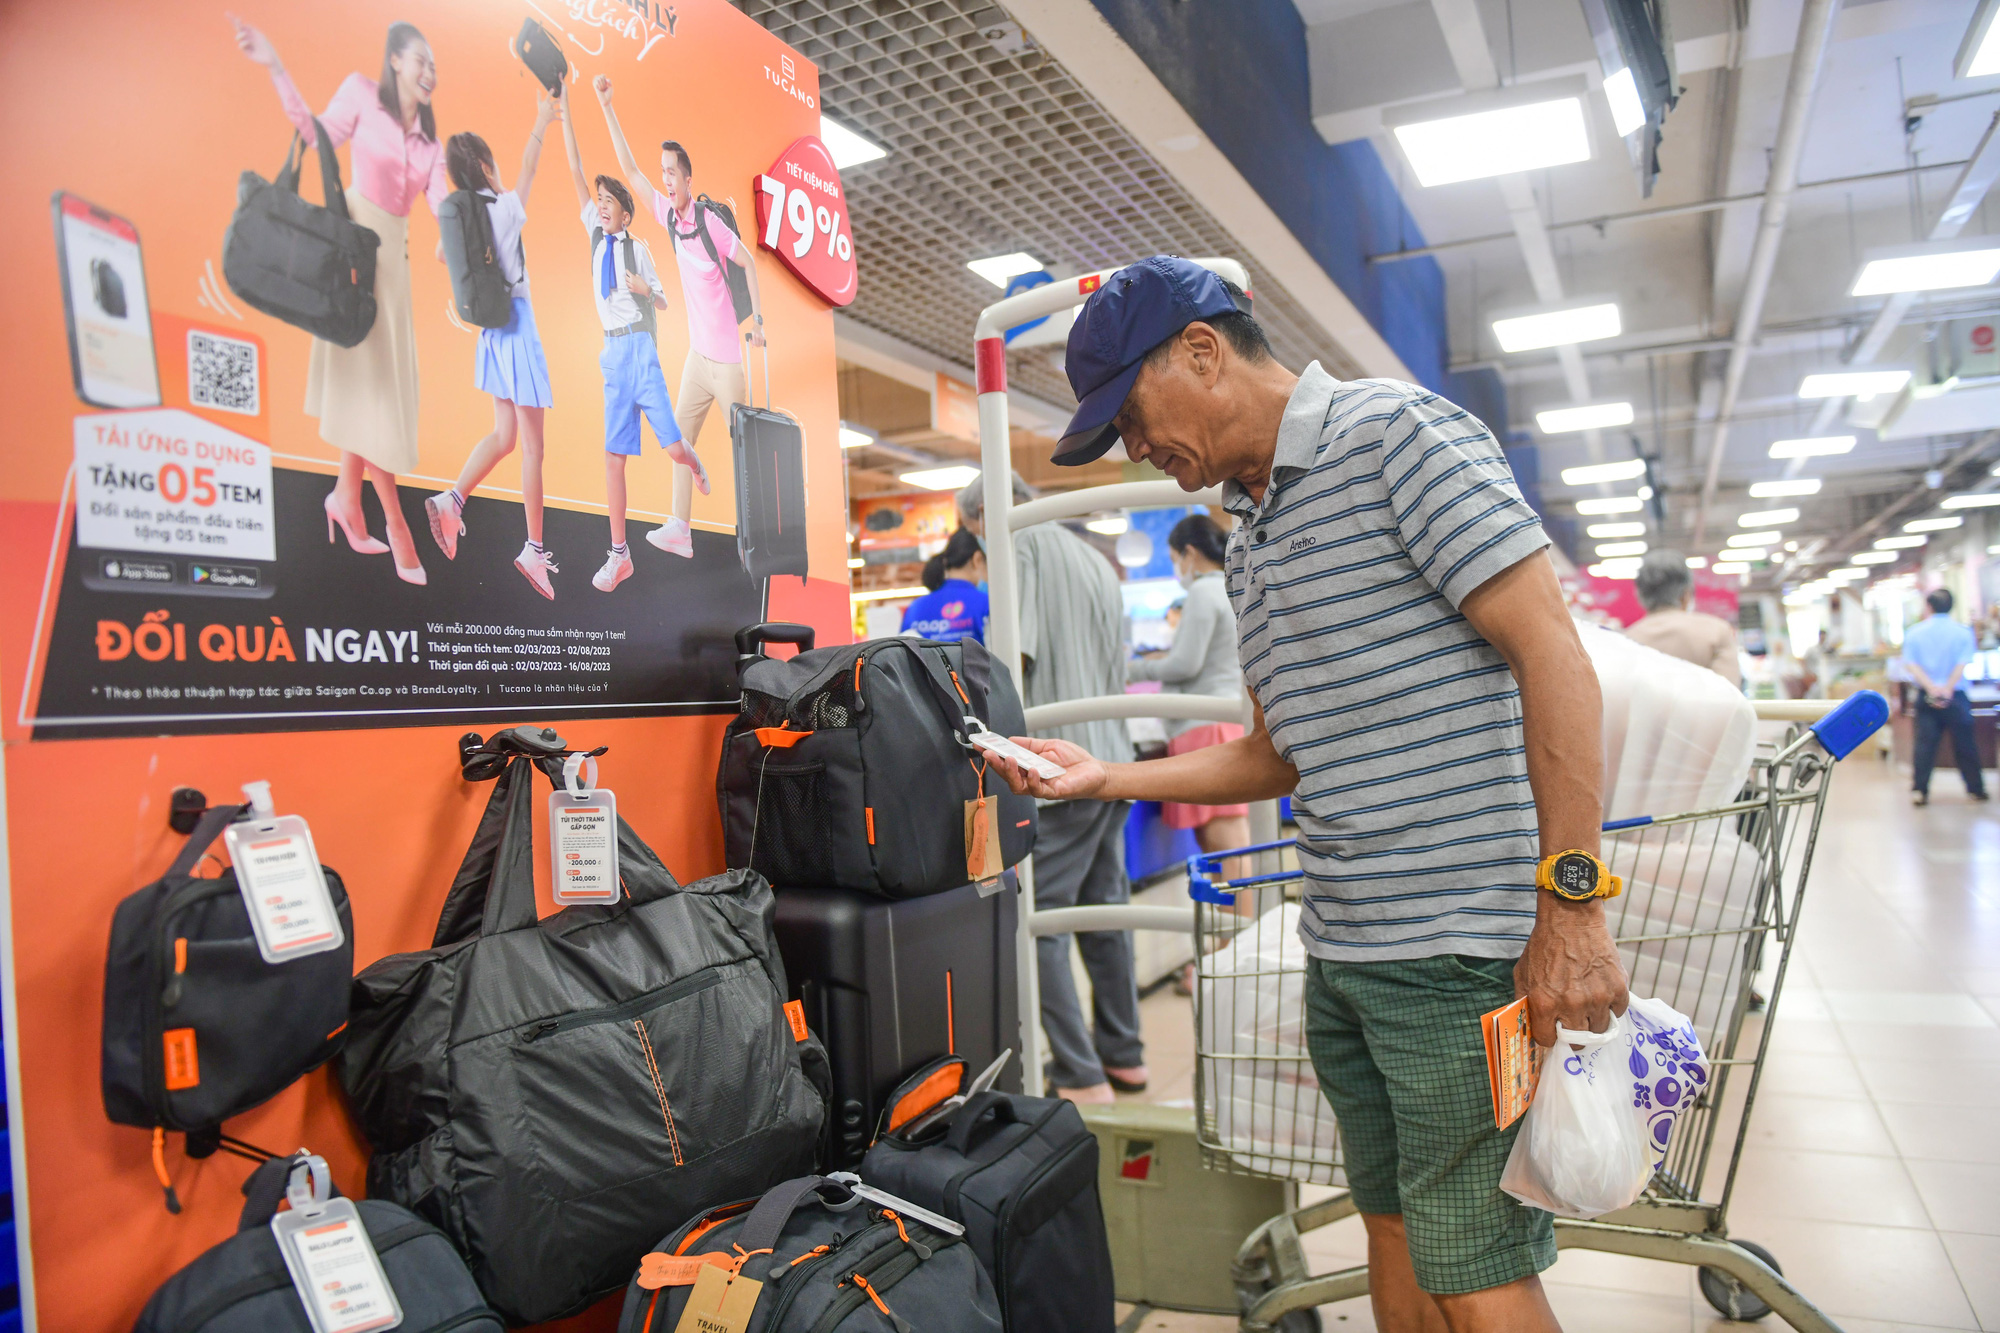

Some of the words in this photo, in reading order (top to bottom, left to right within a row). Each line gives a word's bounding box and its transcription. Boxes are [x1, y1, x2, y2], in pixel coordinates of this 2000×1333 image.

[764, 65, 815, 109] TUCANO
[786, 161, 803, 180] TIẾT
[803, 167, 822, 191] KIỆM
[822, 178, 839, 199] ĐẾN
[761, 173, 851, 262] 79%
[94, 424, 129, 447] TẢI
[137, 428, 188, 456] ỨNG
[195, 442, 256, 466] DỤNG
[89, 463, 155, 494] TẶNG
[158, 462, 217, 507] 05
[219, 483, 262, 506] TEM
[156, 509, 200, 526] phẩm
[135, 525, 171, 543] tặng
[199, 531, 227, 545] tem
[1290, 537, 1317, 552] Aristino
[122, 568, 142, 580] App
[144, 569, 171, 581] Store
[210, 573, 238, 586] Google
[95, 609, 186, 662] ĐỔI
[199, 616, 297, 662] QUÀ
[305, 627, 420, 663] NGAY!
[426, 622, 444, 634] Với
[446, 621, 463, 634] mỗi
[465, 624, 502, 635] 200.000
[503, 625, 526, 638] đồng
[527, 628, 545, 637] mua
[546, 626, 563, 637] sắm
[564, 627, 584, 640] nhận
[585, 630, 604, 641] ngay
[610, 630, 626, 640] tem!
[427, 641, 450, 653] Thời
[451, 642, 473, 654] gian
[473, 642, 491, 653] tích
[493, 644, 513, 654] tem:
[514, 643, 561, 655] 02/03/2023
[567, 644, 611, 656] 02/08/2023
[428, 660, 450, 671] Thời
[453, 661, 473, 673] gian
[475, 659, 490, 671] đổi
[491, 660, 508, 673] quà
[515, 660, 562, 673] 02/03/2023
[569, 661, 611, 673] 16/08/2023
[104, 685, 142, 699] Theo
[395, 685, 408, 695] và
[411, 685, 481, 696] BrandLoyalty.
[499, 684, 531, 693] Tucano
[534, 683, 542, 693] là
[568, 684, 585, 694] hiệu
[587, 684, 601, 693] của
